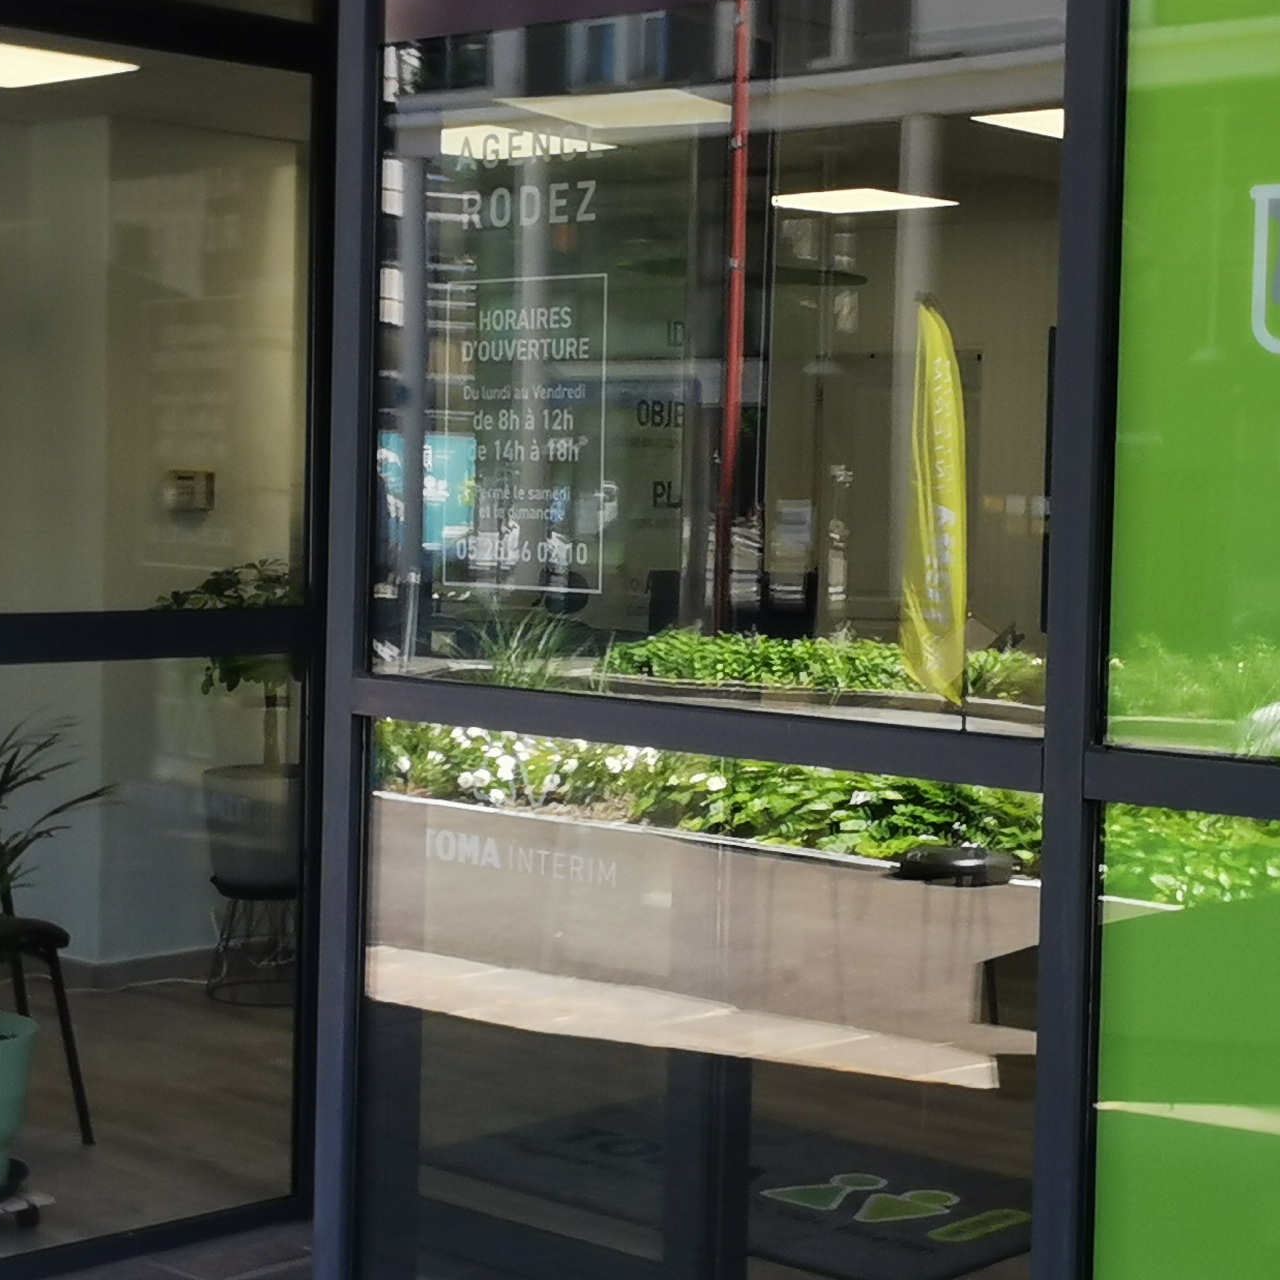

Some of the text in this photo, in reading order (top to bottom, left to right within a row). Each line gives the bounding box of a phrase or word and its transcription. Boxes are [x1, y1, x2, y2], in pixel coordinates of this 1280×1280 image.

[455, 126, 604, 171] AGENCE
[462, 180, 597, 229] RODEZ
[478, 306, 572, 331] HORAIRES
[460, 337, 591, 363] D'OUVERTURE
[472, 408, 574, 431] de 8h à 12h
[494, 439, 525, 462] 14h
[529, 439, 541, 462] à
[547, 439, 579, 462] 18h
[425, 827, 618, 888] TOMA INTERIM
